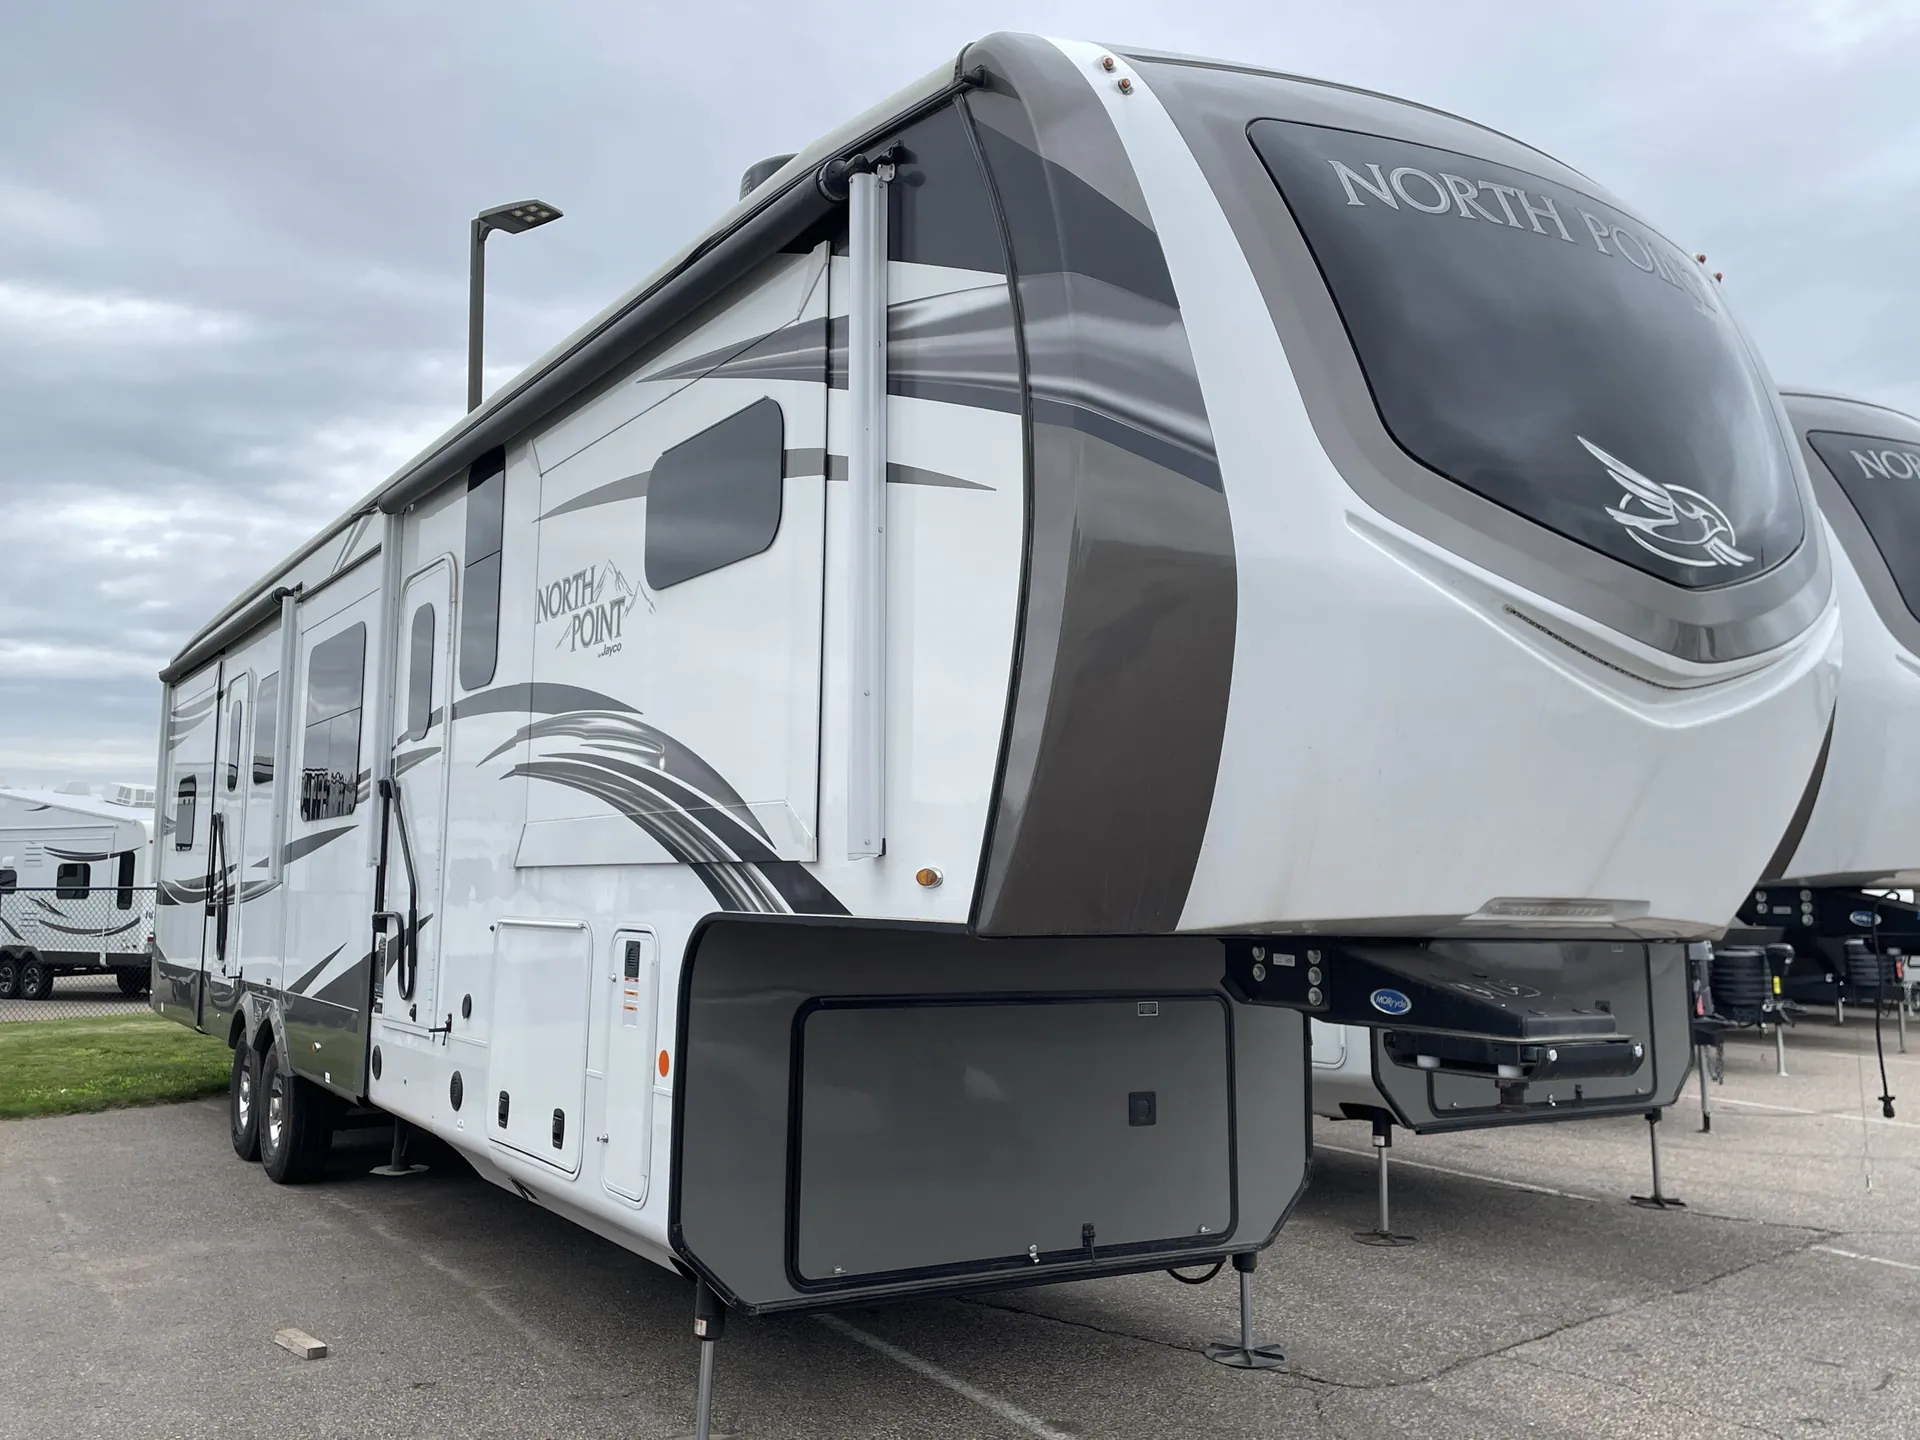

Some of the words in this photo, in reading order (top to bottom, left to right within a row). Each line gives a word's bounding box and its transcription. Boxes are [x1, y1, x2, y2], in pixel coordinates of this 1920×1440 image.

[1328, 159, 1578, 245] NORTH
[536, 564, 597, 625] NORTH
[570, 596, 627, 652] POINT
